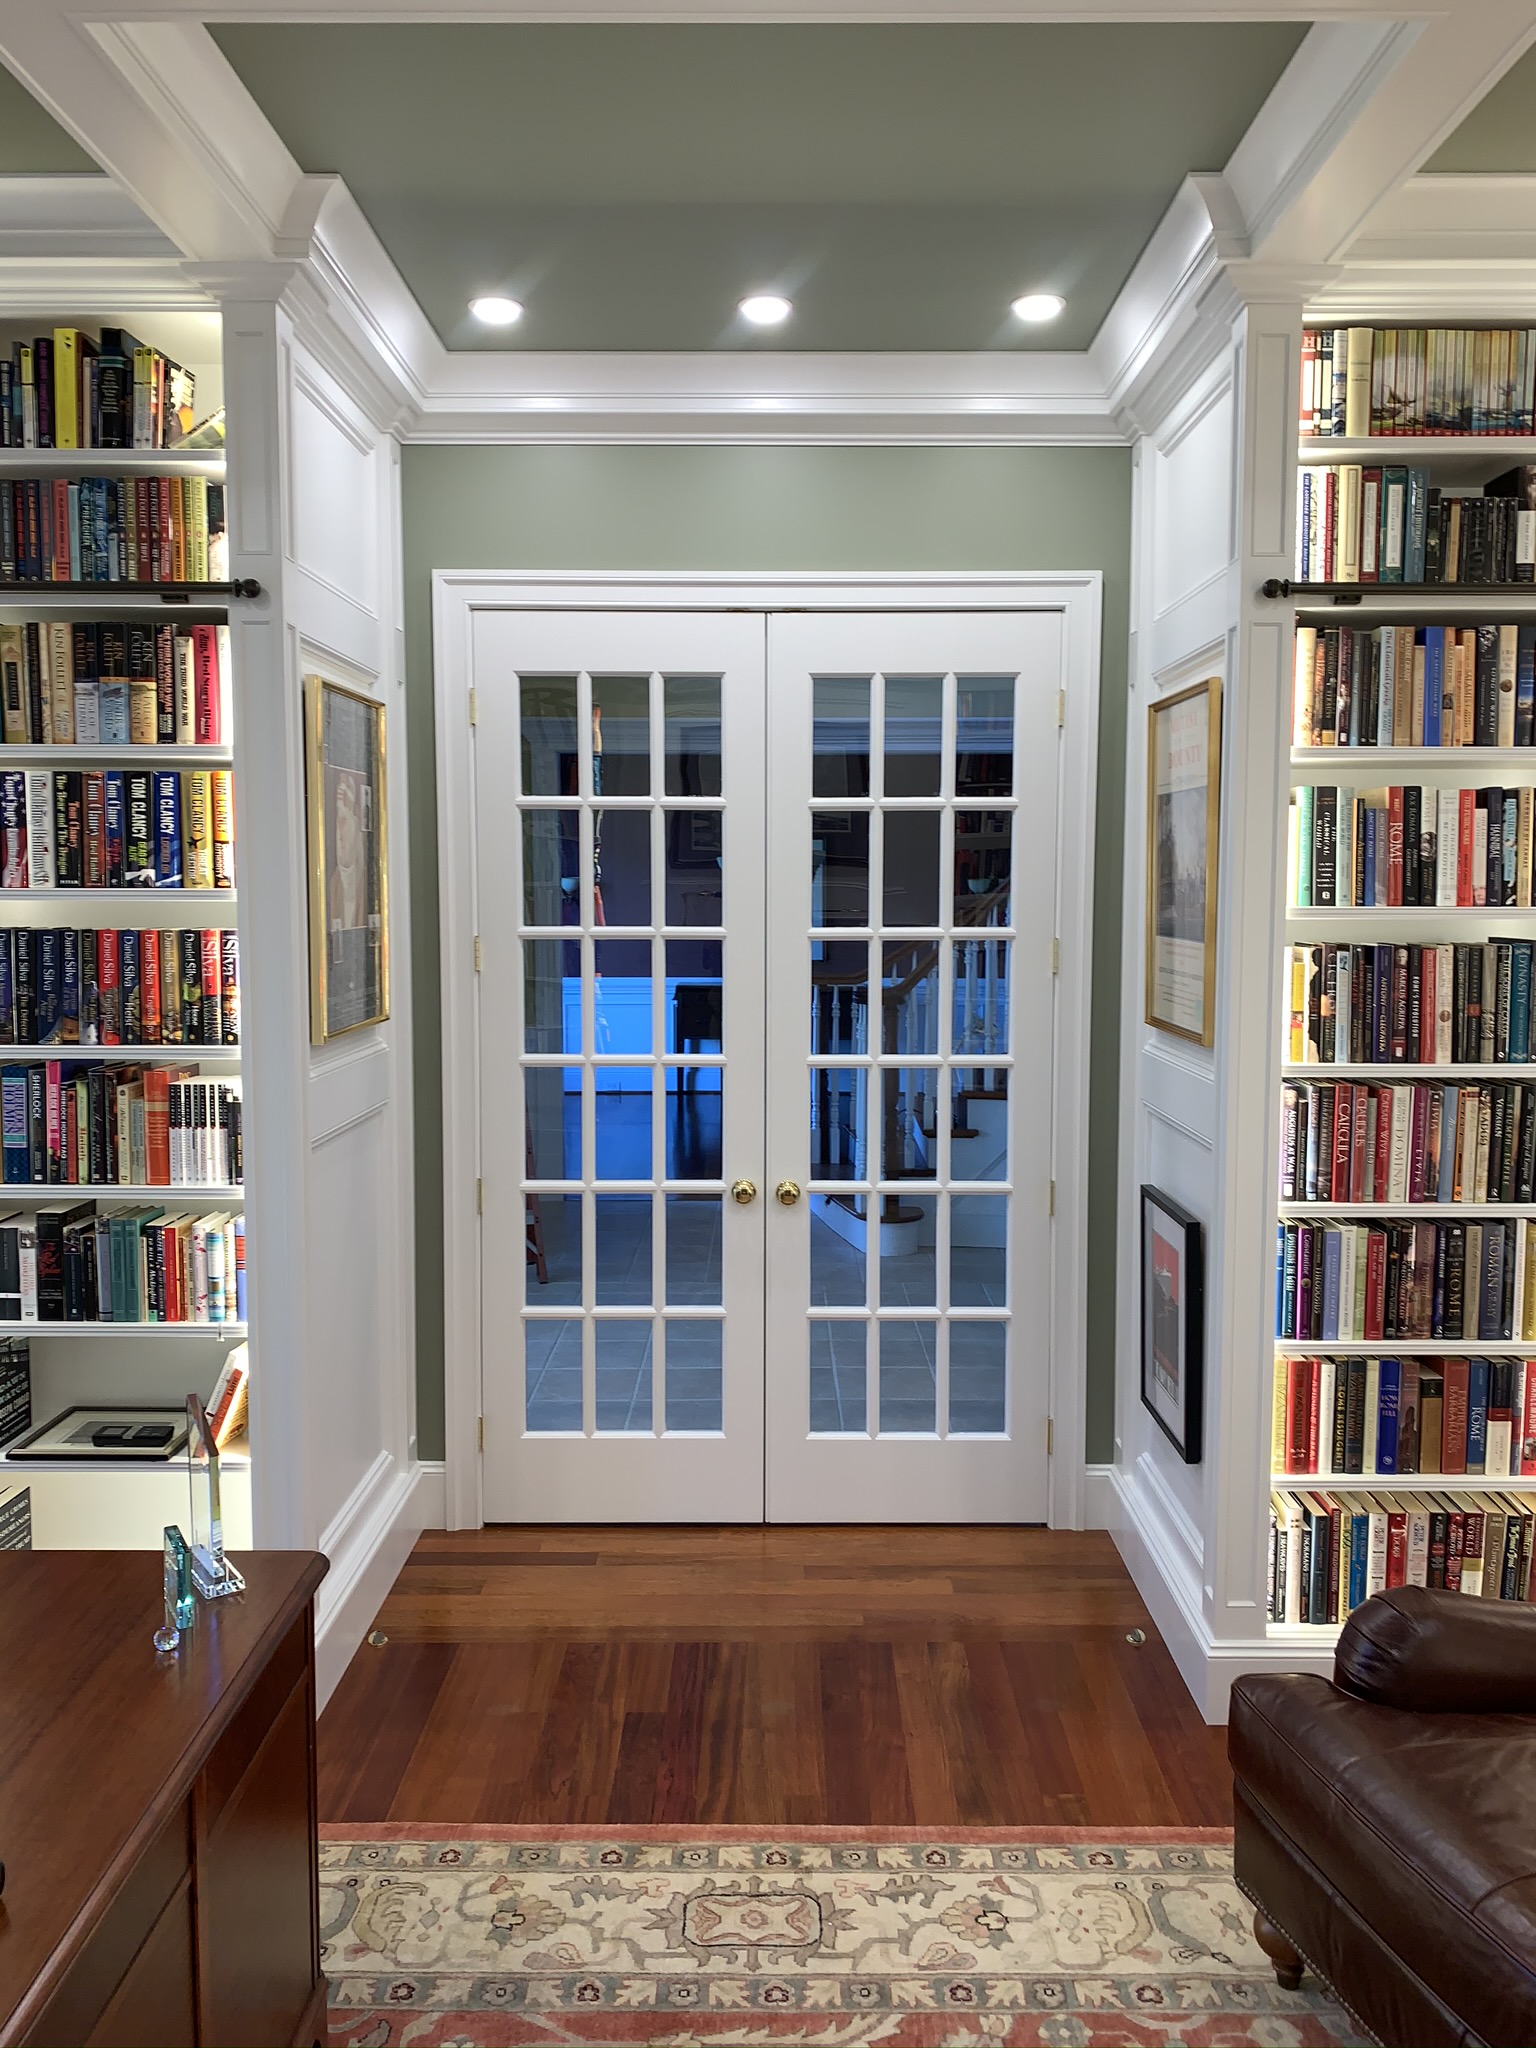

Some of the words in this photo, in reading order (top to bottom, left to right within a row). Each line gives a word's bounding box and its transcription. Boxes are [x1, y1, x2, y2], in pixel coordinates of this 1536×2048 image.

[117, 482, 125, 497] KEN
[127, 482, 135, 497] KEN
[160, 482, 168, 497] KEN
[127, 498, 135, 527] FOLLETT
[150, 498, 158, 527] FOLLETT
[140, 542, 148, 562] TRIPLE
[54, 628, 65, 648] KEN
[162, 626, 171, 639] THE
[1385, 631, 1393, 645] The
[76, 632, 86, 671] FOLLETT
[87, 642, 96, 662] KEN
[103, 632, 112, 666] FOLLETT
[113, 641, 123, 660] KEN
[131, 631, 142, 671] FOLLETT
[142, 641, 152, 662] KEN
[163, 641, 172, 662] THIRD
[56, 651, 66, 691] FOLLETT
[202, 656, 211, 675] Red
[1384, 646, 1392, 681] Classical
[164, 664, 173, 693] WORLD
[203, 678, 211, 707] Storm
[164, 695, 173, 713] WAR
[31, 774, 47, 795] Tom
[56, 774, 68, 790] The
[88, 779, 103, 800] Tom
[107, 779, 121, 798] Tom
[131, 777, 146, 798] TOM
[160, 776, 174, 796] TOM
[192, 777, 203, 795] TOM
[215, 777, 226, 795] TOM
[31, 796, 48, 827] Clancy
[56, 791, 68, 811] Bear
[68, 801, 80, 819] Tom
[105, 800, 121, 830] Clancy
[57, 813, 68, 827] and
[85, 803, 103, 836] Clancy
[132, 802, 147, 839] CLANCY
[160, 799, 174, 834] CLANCY
[192, 799, 204, 833] CLANCY
[216, 799, 228, 833] CLANCY
[1408, 808, 1417, 842] ROMANA
[57, 829, 68, 844] The
[67, 821, 81, 848] Clancy
[90, 840, 99, 855] Red
[138, 841, 146, 856] DEAD
[1390, 822, 1403, 865] ROME
[1490, 824, 1501, 859] HANNIBAL
[56, 847, 69, 875] Dragon
[128, 846, 137, 862] ALIVE
[138, 858, 147, 866] OR
[160, 837, 169, 862] LOCKED
[199, 849, 208, 875] THREAT
[215, 843, 224, 878] AUTHORITY
[90, 857, 100, 882] Rabbit
[161, 864, 169, 874] ON
[188, 851, 196, 879] VECTOR
[18, 932, 29, 960] Daniel
[42, 936, 54, 966] Daniel
[64, 932, 75, 960] Daniel
[83, 933, 93, 960] Daniel
[103, 934, 114, 961] Daniel
[123, 937, 134, 963] Daniel
[145, 934, 155, 962] Daniel
[164, 932, 173, 960] Daniel
[184, 933, 195, 961] Daniel
[202, 940, 218, 977] Silva
[222, 939, 240, 976] Silva
[19, 962, 31, 981] Silva
[43, 969, 55, 991] Silva
[65, 961, 77, 983] Silva
[84, 964, 93, 985] Silva
[104, 963, 115, 984] Silva
[124, 965, 135, 987] Silva
[145, 963, 156, 985] Silva
[165, 962, 175, 983] Silva
[184, 962, 196, 984] Silva
[1399, 969, 1407, 998] MARCUS
[1517, 955, 1528, 1004] DYNASTY
[20, 1010, 29, 1036] Defector
[124, 1003, 134, 1026] Heist
[1398, 999, 1406, 1029] AGRIPPA
[3, 1084, 15, 1133] HOLMES
[14, 1084, 25, 1133] SHERLOCK
[32, 1074, 42, 1118] SHERLOCK
[1288, 1109, 1296, 1145] AUGUSTUS
[1355, 1098, 1367, 1147] CLAUDIUS
[1431, 1102, 1440, 1129] LIVIA
[1495, 1098, 1504, 1137] VESPASIAN
[1505, 1104, 1513, 1144] TRIUMPH
[1337, 1103, 1350, 1163] CALIGULA
[1287, 1156, 1295, 1173] WAR
[1288, 1147, 1295, 1155] AT
[1393, 1129, 1403, 1186] DOMINA
[1414, 1149, 1423, 1183] LIVIA
[1503, 1153, 1511, 1184] EMPIRE
[1303, 1234, 1311, 1275] Constantine
[1487, 1236, 1500, 1287] ROMAN
[1449, 1267, 1461, 1316] ROME
[1487, 1289, 1496, 1318] ARMY
[1448, 1385, 1458, 1453] BARBARIANS
[1456, 1390, 1467, 1433] EMPIRES
[1471, 1407, 1481, 1440] ROME
[1336, 1414, 1344, 1463] RESURGENT
[1343, 1530, 1352, 1549] 1066
[1466, 1517, 1475, 1555] WORLD
[1522, 1520, 1533, 1557] Lionheart
[1488, 1542, 1500, 1591] Plantagenets
